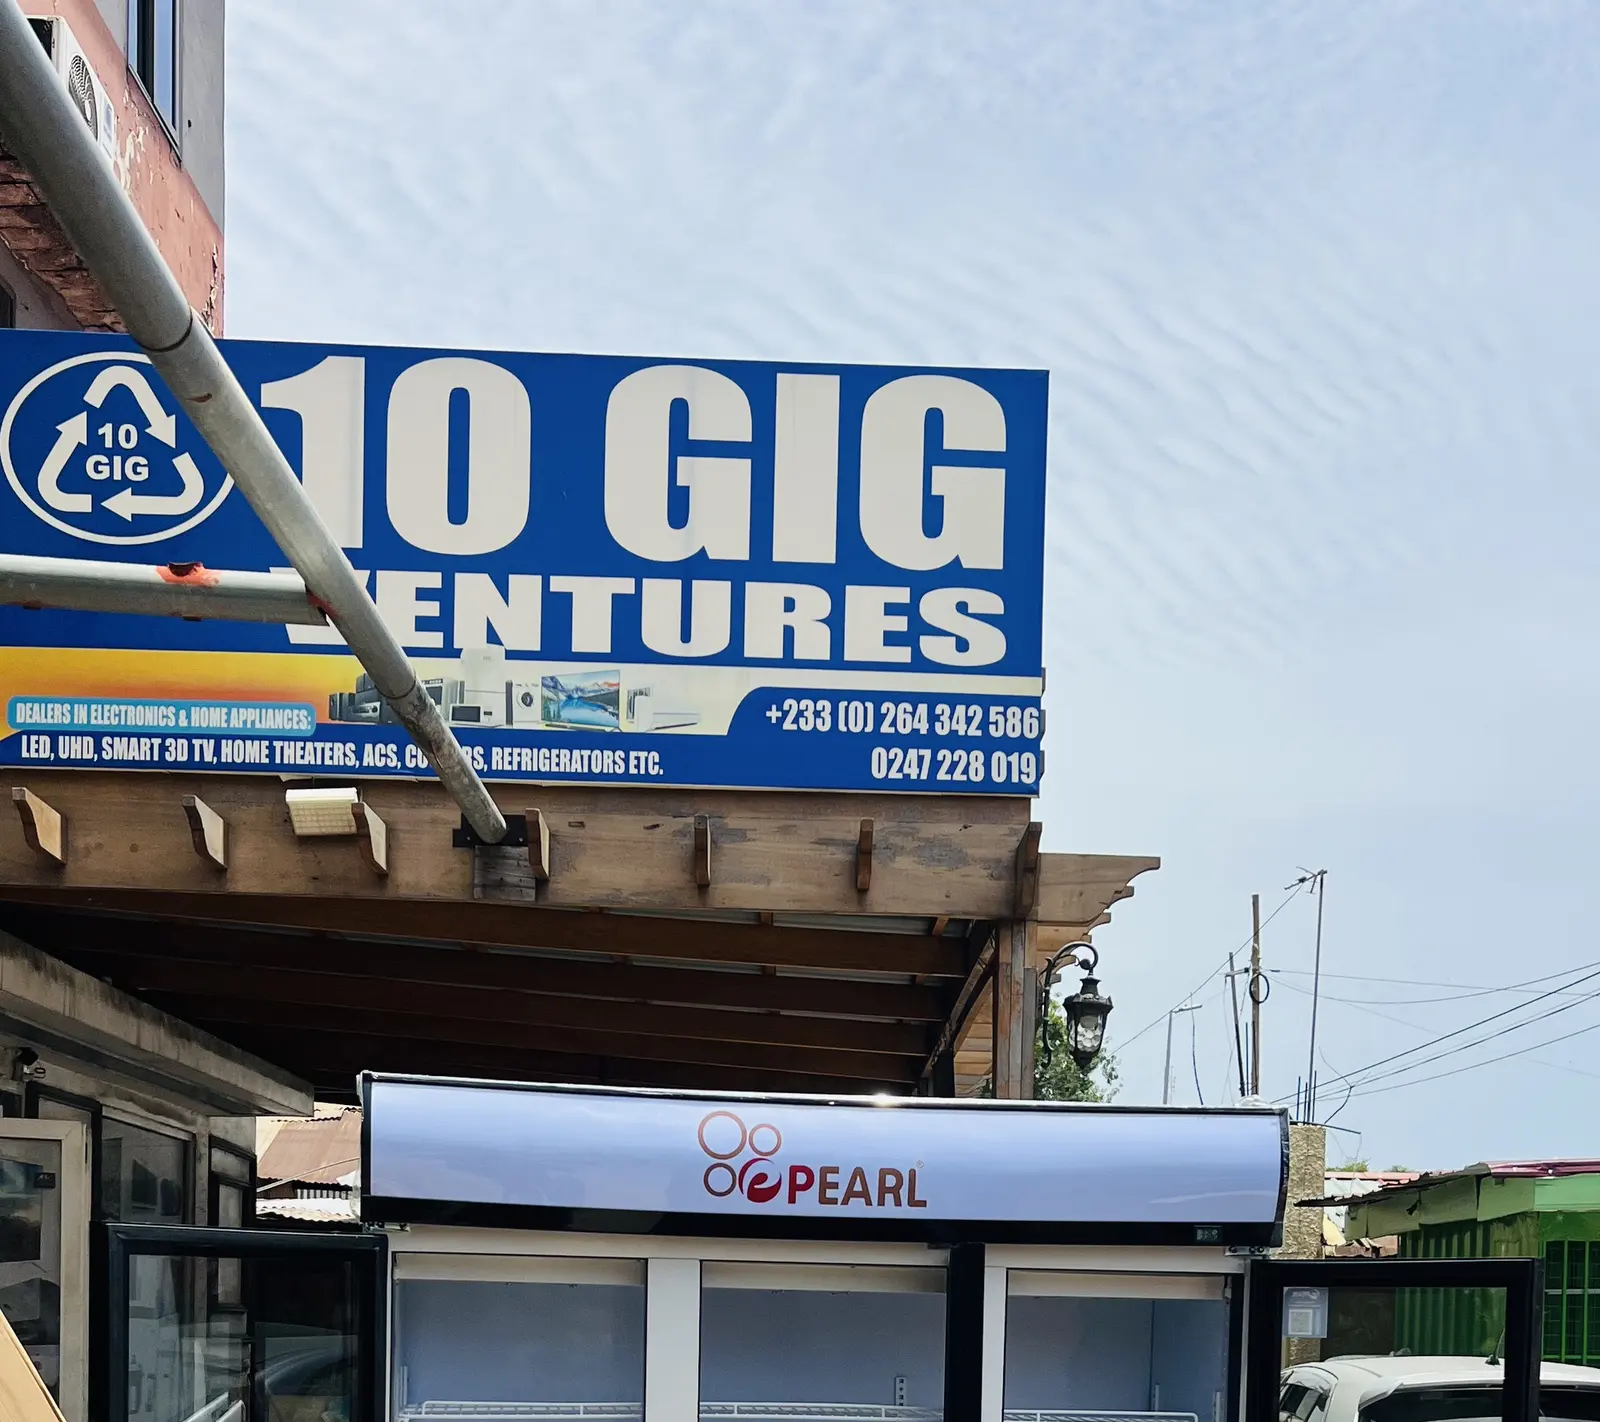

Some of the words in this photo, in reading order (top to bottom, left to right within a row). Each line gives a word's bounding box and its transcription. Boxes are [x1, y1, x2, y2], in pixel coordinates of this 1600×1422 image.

[97, 422, 138, 450] 10
[85, 454, 149, 482] GIG
[260, 355, 532, 556] 10
[604, 364, 1007, 571] GIG
[16, 702, 71, 724] DEALERS
[73, 703, 88, 724] IN
[90, 704, 176, 727] ELECTRONICS
[178, 709, 188, 727] &
[190, 706, 228, 728] HOME
[229, 708, 311, 730] APPLIANCES:
[765, 698, 832, 732] +233
[838, 700, 874, 733] (0)
[879, 701, 929, 735] 264
[934, 703, 983, 737] 342
[988, 705, 1039, 739] 586
[21, 735, 54, 761] LED,
[58, 735, 98, 762] UHD,
[101, 736, 162, 761] SMART
[165, 738, 188, 762] 3D
[192, 738, 218, 765] TV,
[220, 739, 270, 763] HOME
[273, 740, 359, 769] THEATERS,
[362, 743, 401, 769] ACS,
[491, 746, 626, 774] REFRIGERATORS
[628, 751, 664, 776] ETC.
[871, 747, 932, 780] 0247
[936, 749, 985, 783] 228
[990, 751, 1037, 784] 019
[787, 1165, 928, 1208] PEARL
